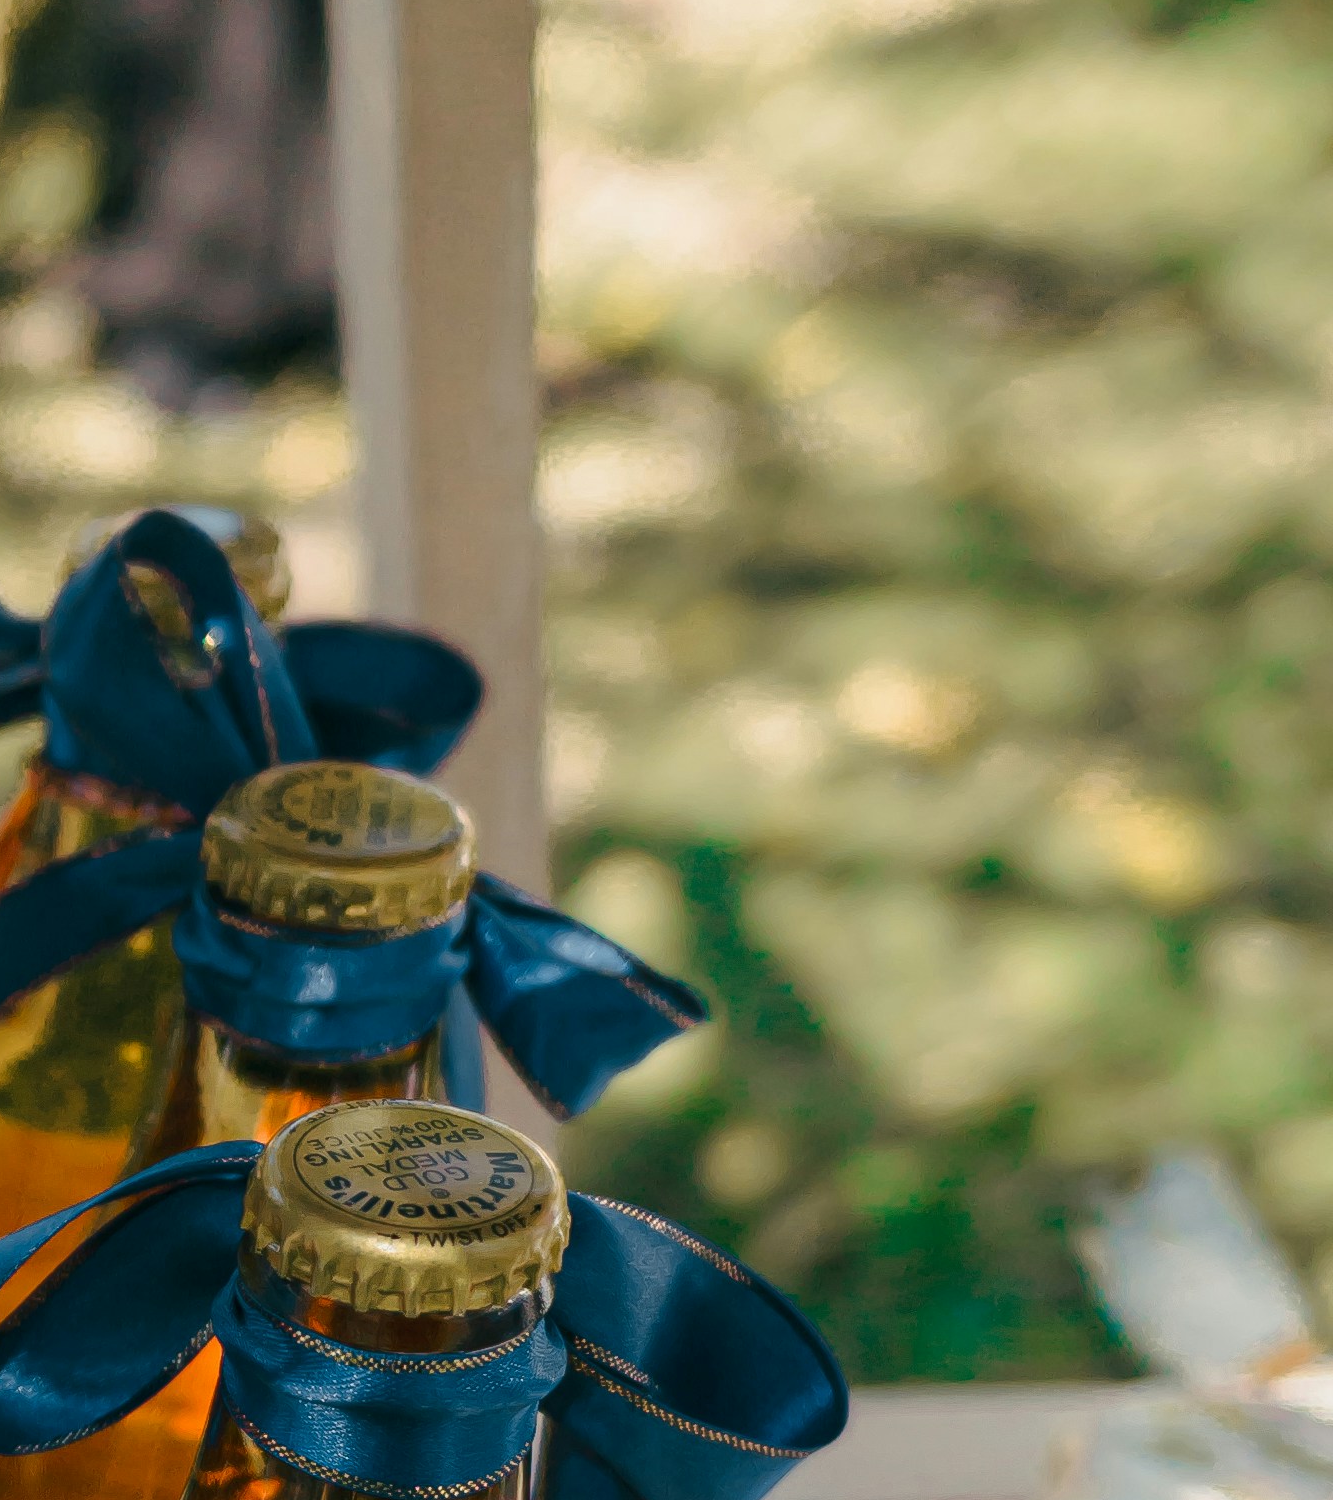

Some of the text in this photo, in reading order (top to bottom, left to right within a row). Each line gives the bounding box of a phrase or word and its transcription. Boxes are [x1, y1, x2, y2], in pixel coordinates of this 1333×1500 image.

[303, 1127, 485, 1168] SPARKLING
[306, 1116, 460, 1151] 100% JUICE
[349, 1148, 469, 1178] MEDAL
[382, 1165, 470, 1192] GOLD
[324, 1150, 527, 1221] Martinelli's
[408, 1213, 529, 1248] TWIST OFF
